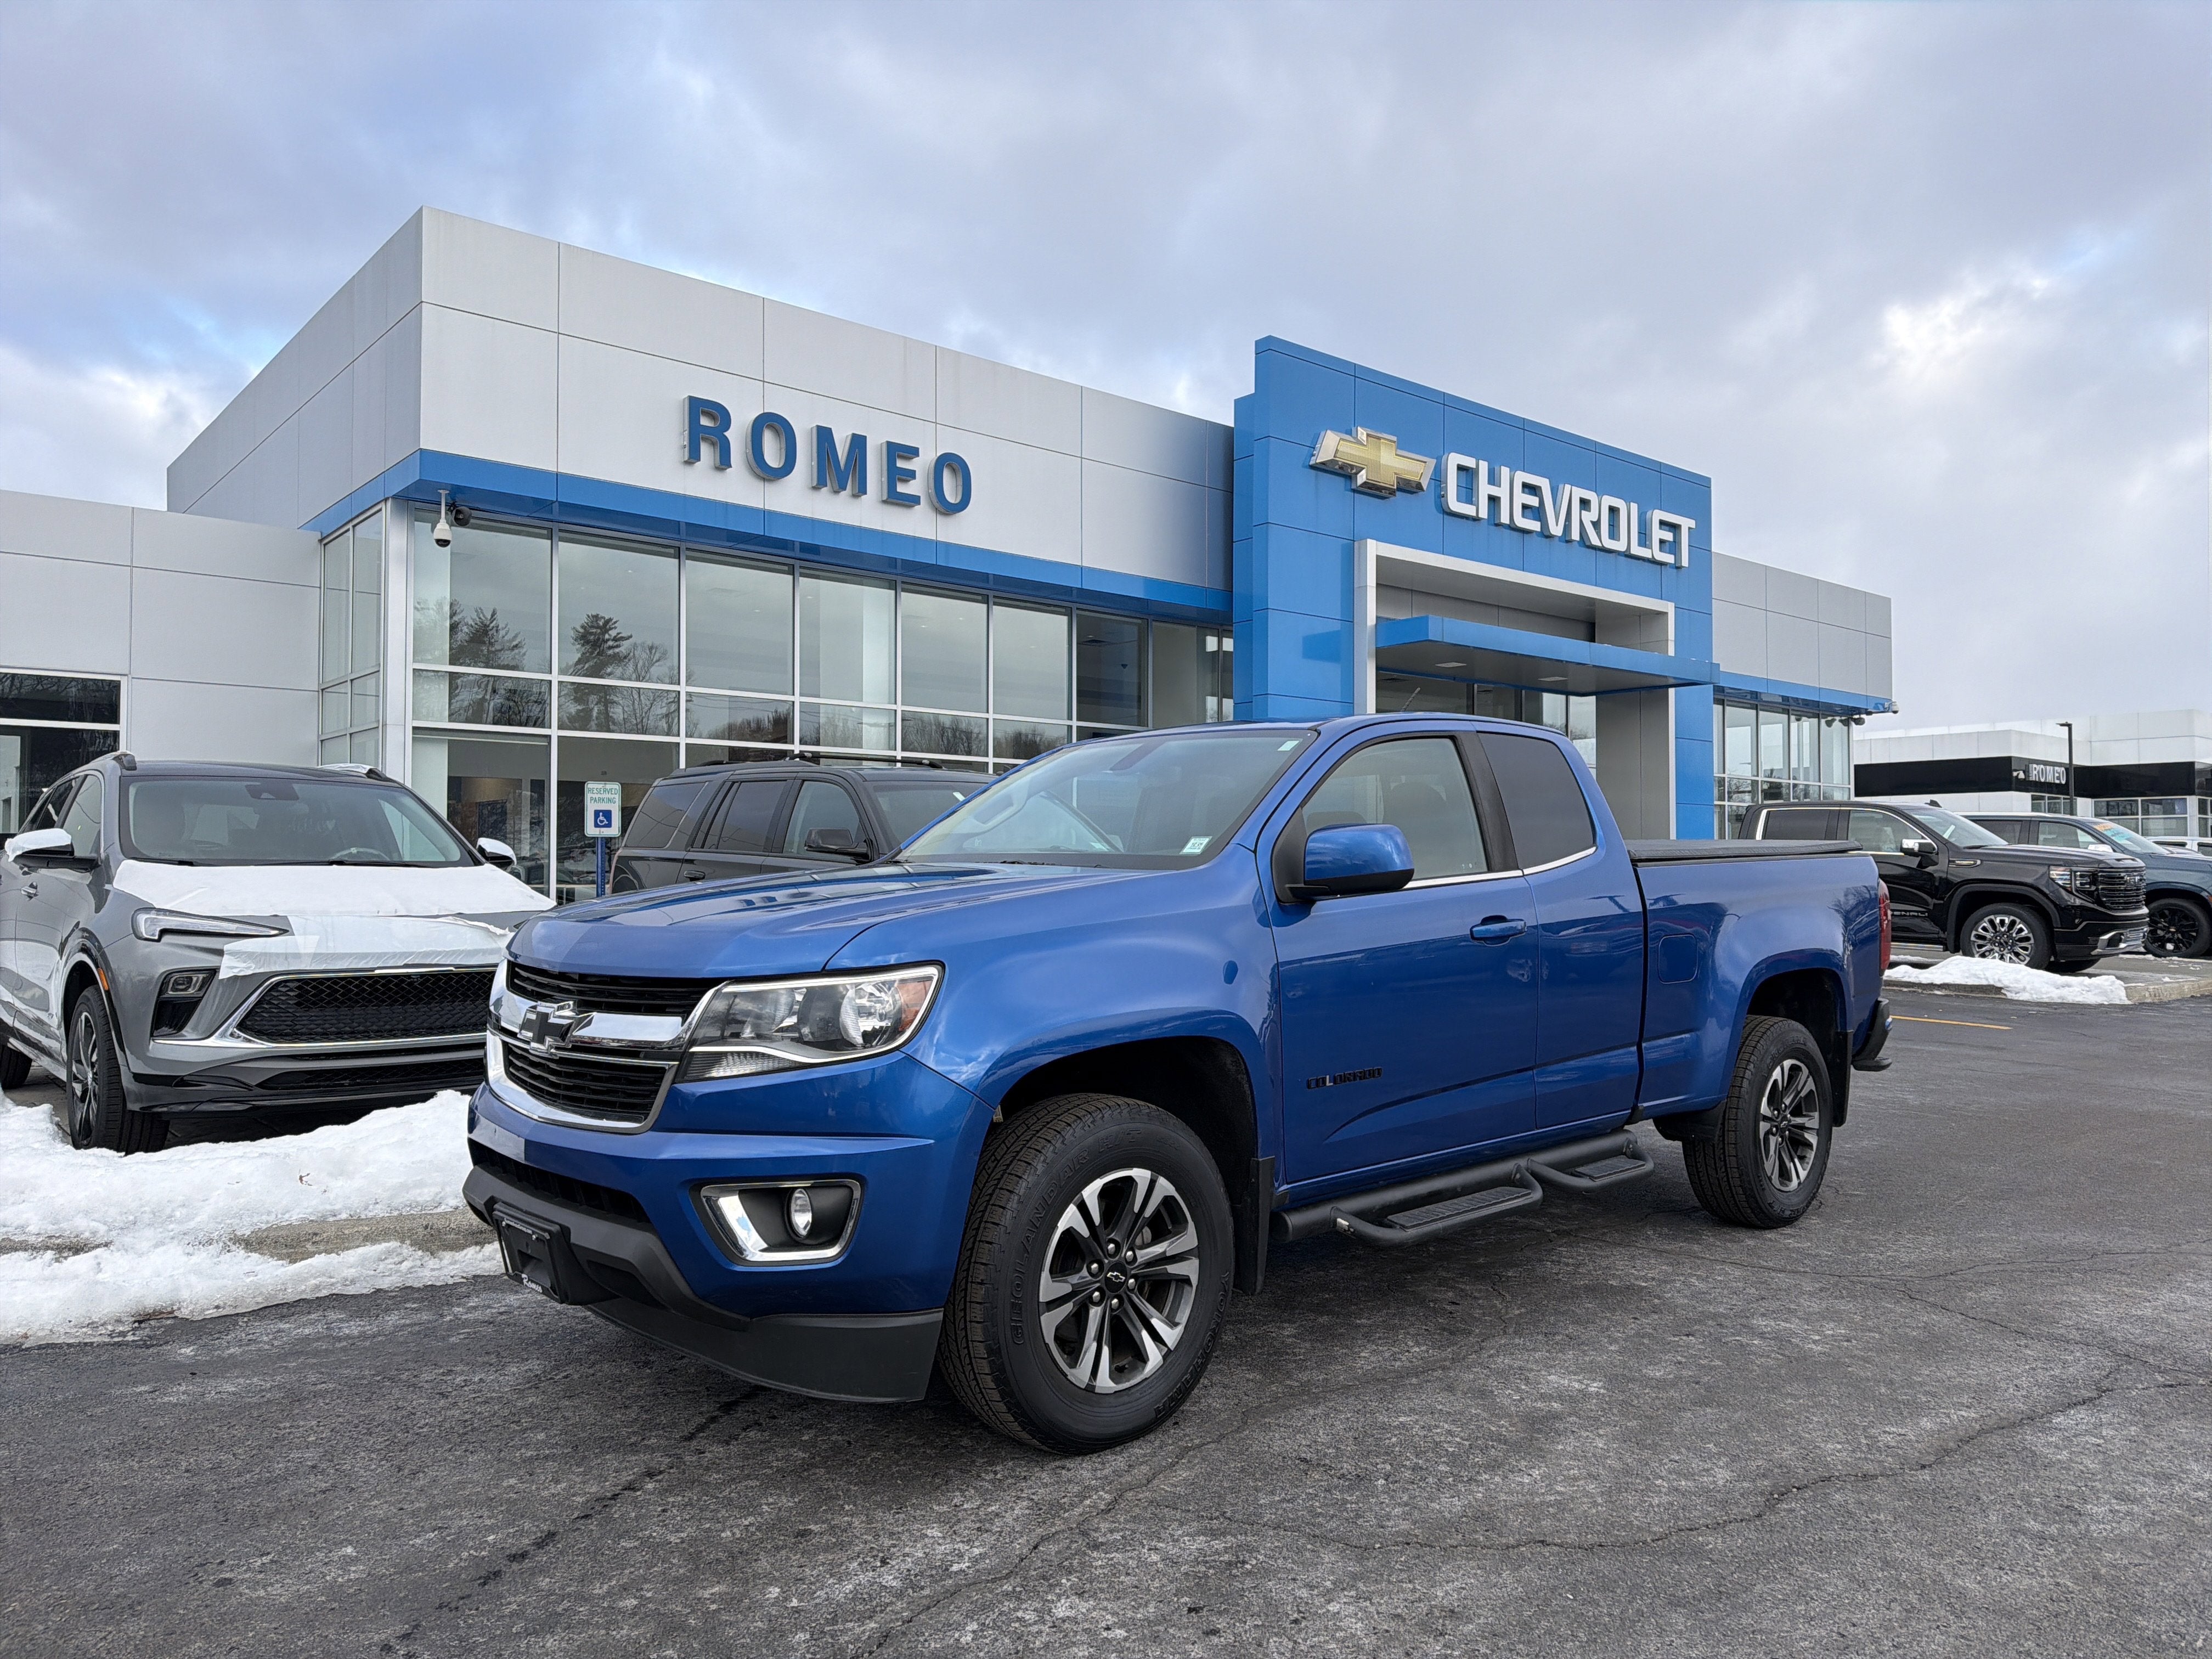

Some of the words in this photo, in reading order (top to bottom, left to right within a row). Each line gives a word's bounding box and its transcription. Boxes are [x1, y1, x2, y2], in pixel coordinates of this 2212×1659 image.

[684, 396, 972, 514] ROMEO
[1442, 452, 1695, 569] CHEVROLET
[2029, 764, 2066, 784] ROMEO
[1307, 1067, 1382, 1089] COLORADO
[1011, 1149, 1089, 1344] GEOLANDAR
